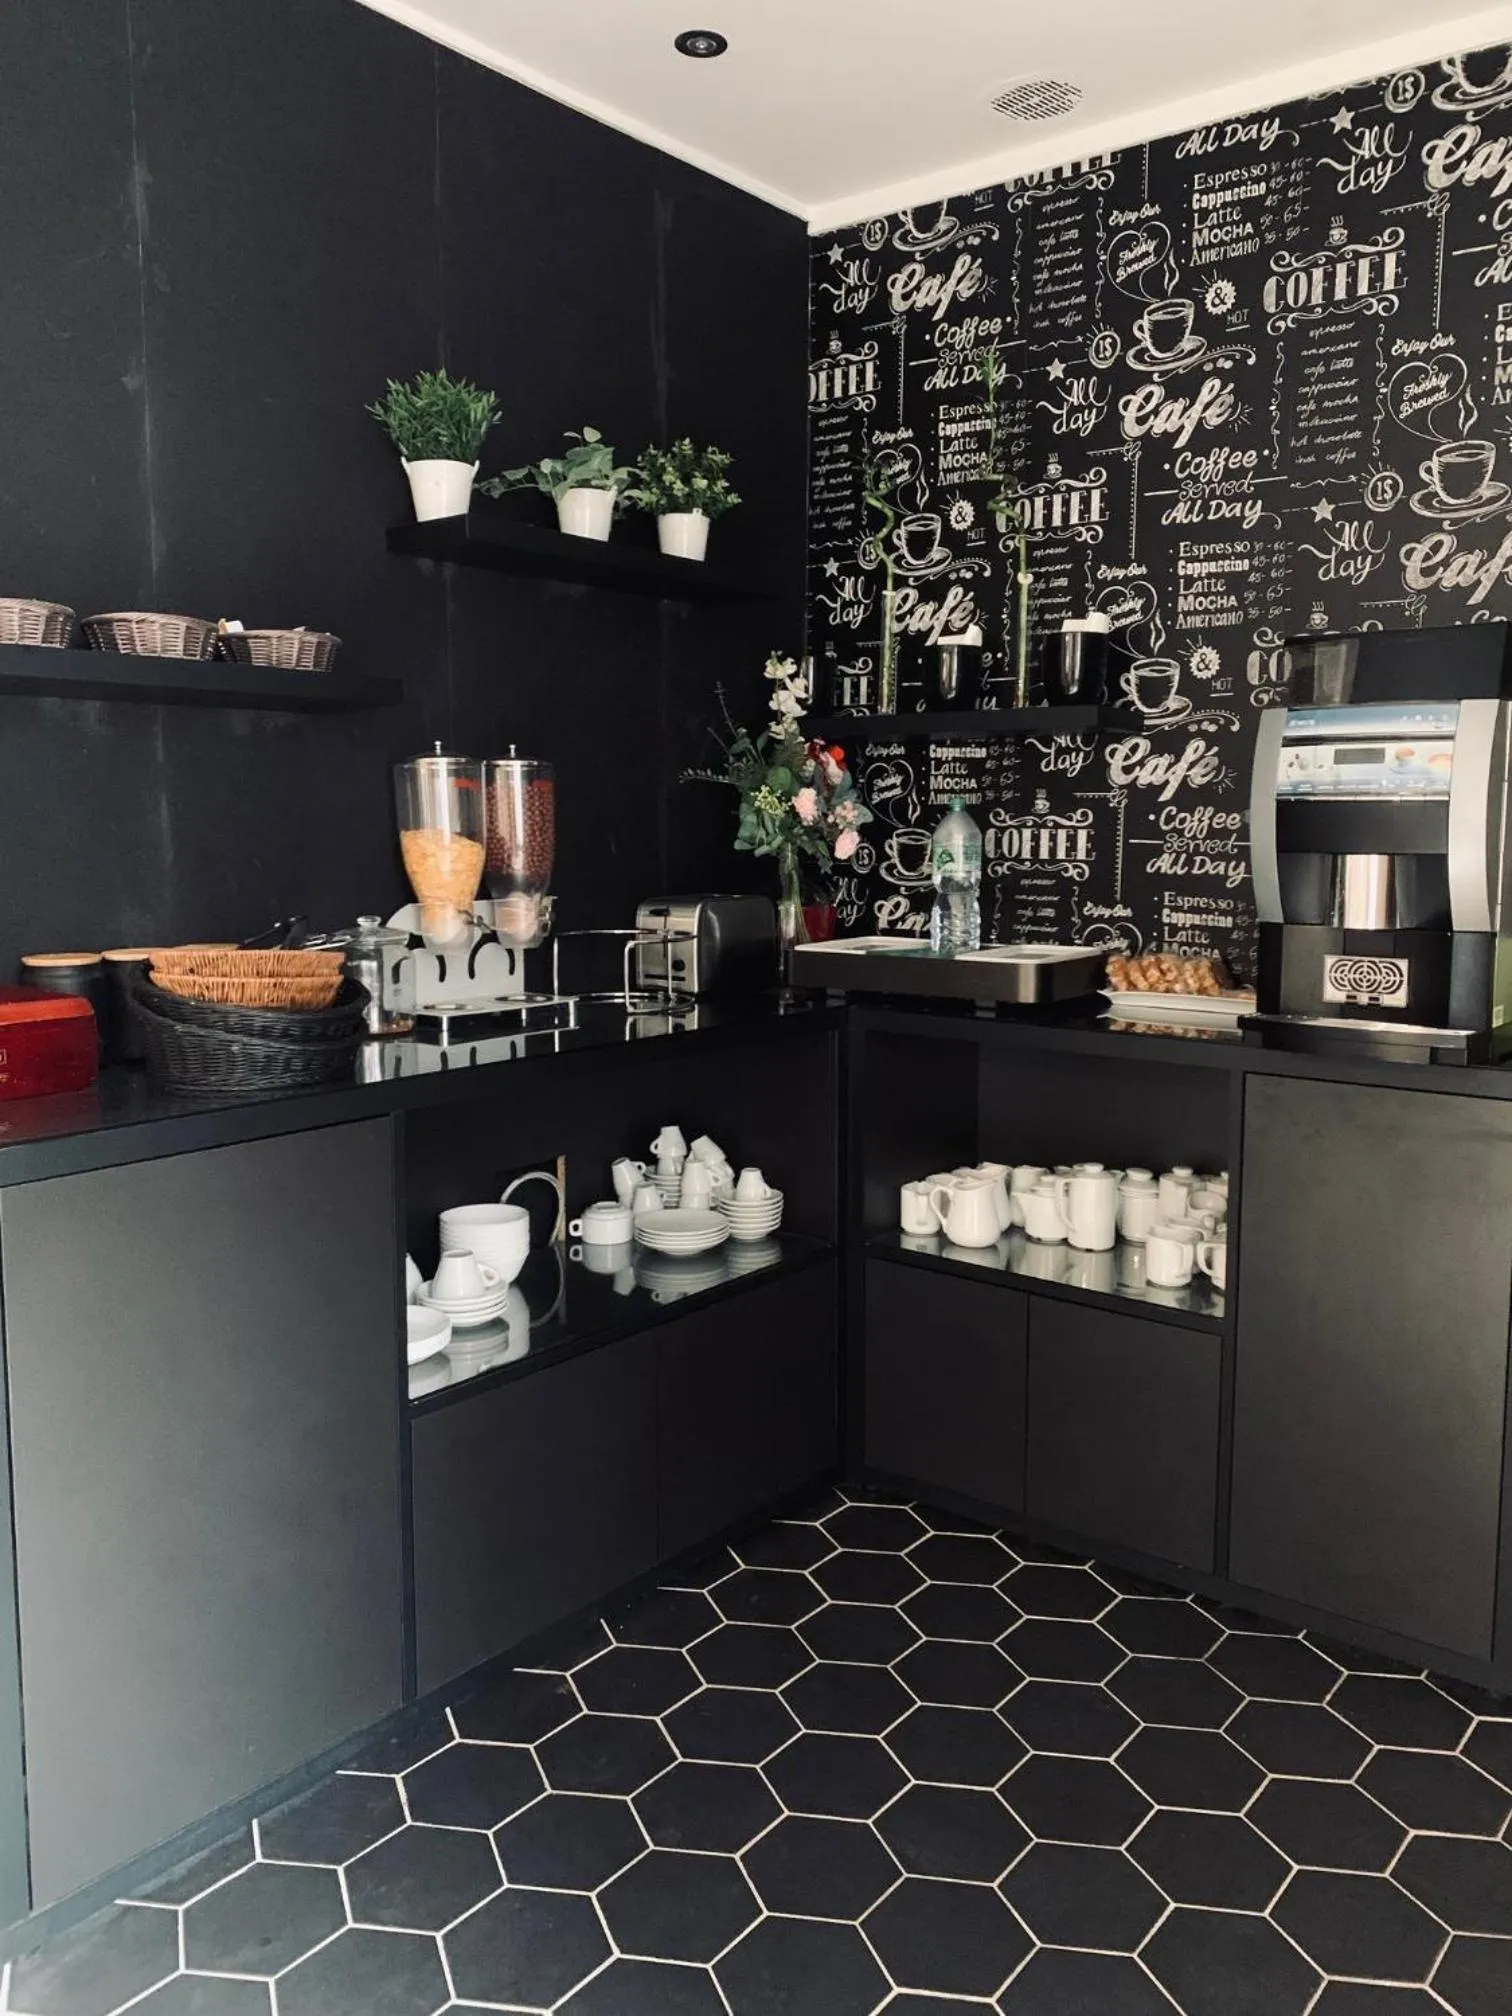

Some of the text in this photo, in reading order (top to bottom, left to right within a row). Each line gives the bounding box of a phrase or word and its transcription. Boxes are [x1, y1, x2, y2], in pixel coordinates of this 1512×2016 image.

[1175, 117, 1282, 159] All Day
[1343, 122, 1414, 158] All
[1193, 163, 1267, 190] Espresso
[1316, 155, 1407, 194] day
[1192, 180, 1267, 211] Cappuccino
[1193, 206, 1242, 229] Latte
[1190, 237, 1260, 267] Americano
[836, 258, 881, 287] All
[887, 253, 986, 321] Café
[1262, 249, 1409, 314] COFFEE
[819, 282, 879, 314] day
[934, 316, 1003, 349] Coffee
[1228, 309, 1250, 325] HOT
[924, 364, 960, 391] All
[1056, 375, 1112, 407] All
[1036, 398, 1107, 437] day
[1118, 376, 1236, 450] Café
[940, 436, 979, 454] Latte
[1174, 446, 1259, 482] Coffee
[1179, 470, 1256, 501] Served
[1161, 498, 1264, 530] All Day
[1179, 541, 1251, 561] Espresso
[1324, 520, 1391, 551] All
[1177, 556, 1250, 579] Cappuccino
[1298, 543, 1386, 585] day
[1400, 530, 1512, 605] Caf
[1178, 578, 1227, 594] Latte
[1176, 611, 1244, 630] Americano
[1210, 677, 1233, 692] HOT
[929, 743, 987, 760] Cappuccino
[1025, 739, 1094, 778] day
[931, 760, 968, 775] Latte
[1105, 736, 1220, 802] Café
[1159, 806, 1242, 842] Coffee
[983, 828, 1096, 861] COFFEE
[1163, 832, 1239, 854] Served
[1146, 853, 1247, 888] All Day
[1163, 891, 1234, 911] Espresso
[1162, 908, 1234, 928] Cappuccino
[1163, 926, 1210, 944] Latte
